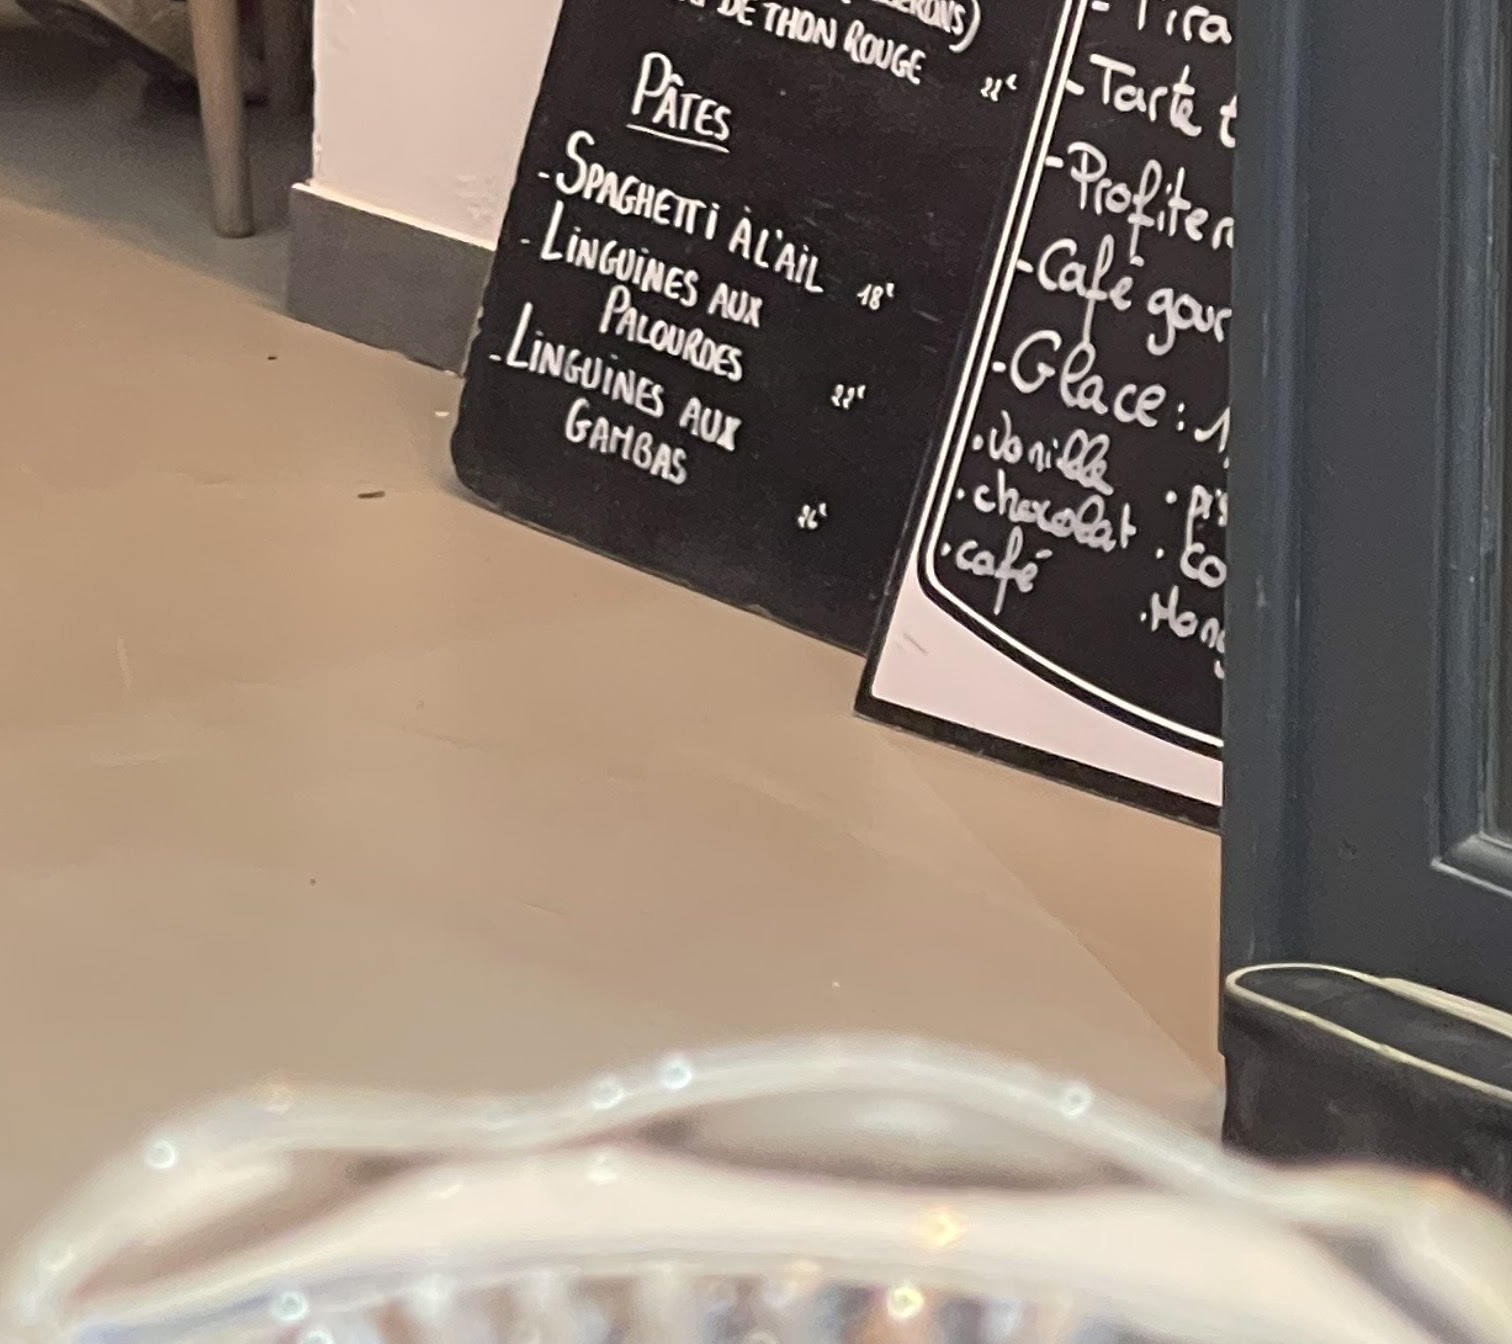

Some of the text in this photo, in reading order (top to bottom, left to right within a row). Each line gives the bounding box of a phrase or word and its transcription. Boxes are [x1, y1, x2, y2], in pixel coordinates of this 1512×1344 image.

[763, 2, 836, 49] THON
[843, 20, 926, 84] ROUGE
[632, 52, 732, 141] PÂTES
[1090, 53, 1202, 137] Tarte
[1067, 141, 1235, 266] Profiter
[599, 285, 742, 381] PALOURDES
[707, 282, 763, 328] AUX
[565, 397, 687, 484] GAMBAS
[679, 397, 742, 451] AUX
